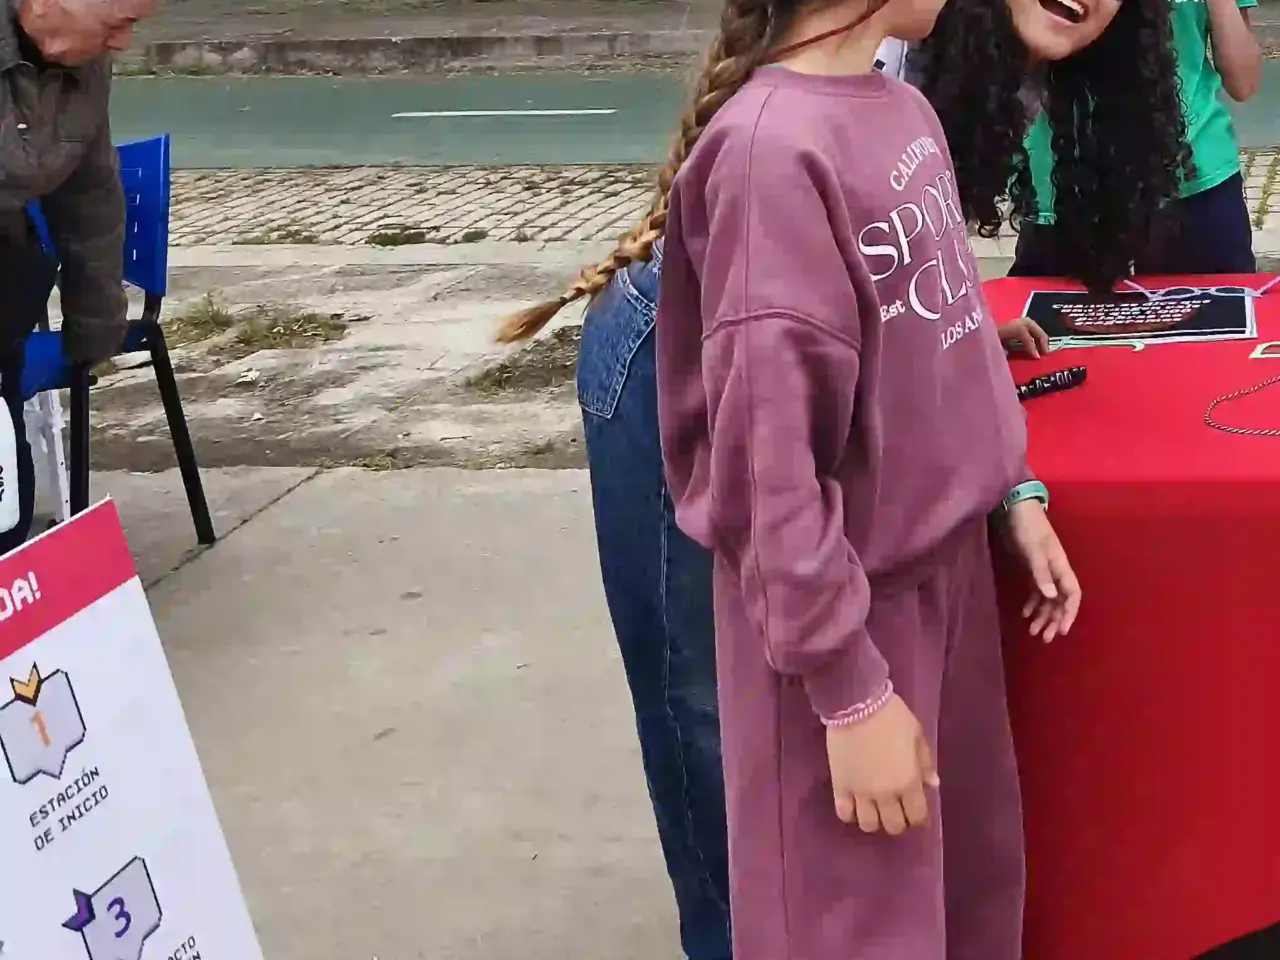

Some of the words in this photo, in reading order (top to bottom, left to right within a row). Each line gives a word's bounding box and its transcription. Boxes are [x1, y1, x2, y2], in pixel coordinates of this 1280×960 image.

[880, 299, 906, 323] Est
[941, 321, 964, 350] LOS
[29, 711, 51, 746] 1
[28, 767, 100, 828] ESTACIÓN
[34, 827, 55, 851] DE
[59, 784, 110, 831] INICIO
[106, 896, 132, 938] 3
